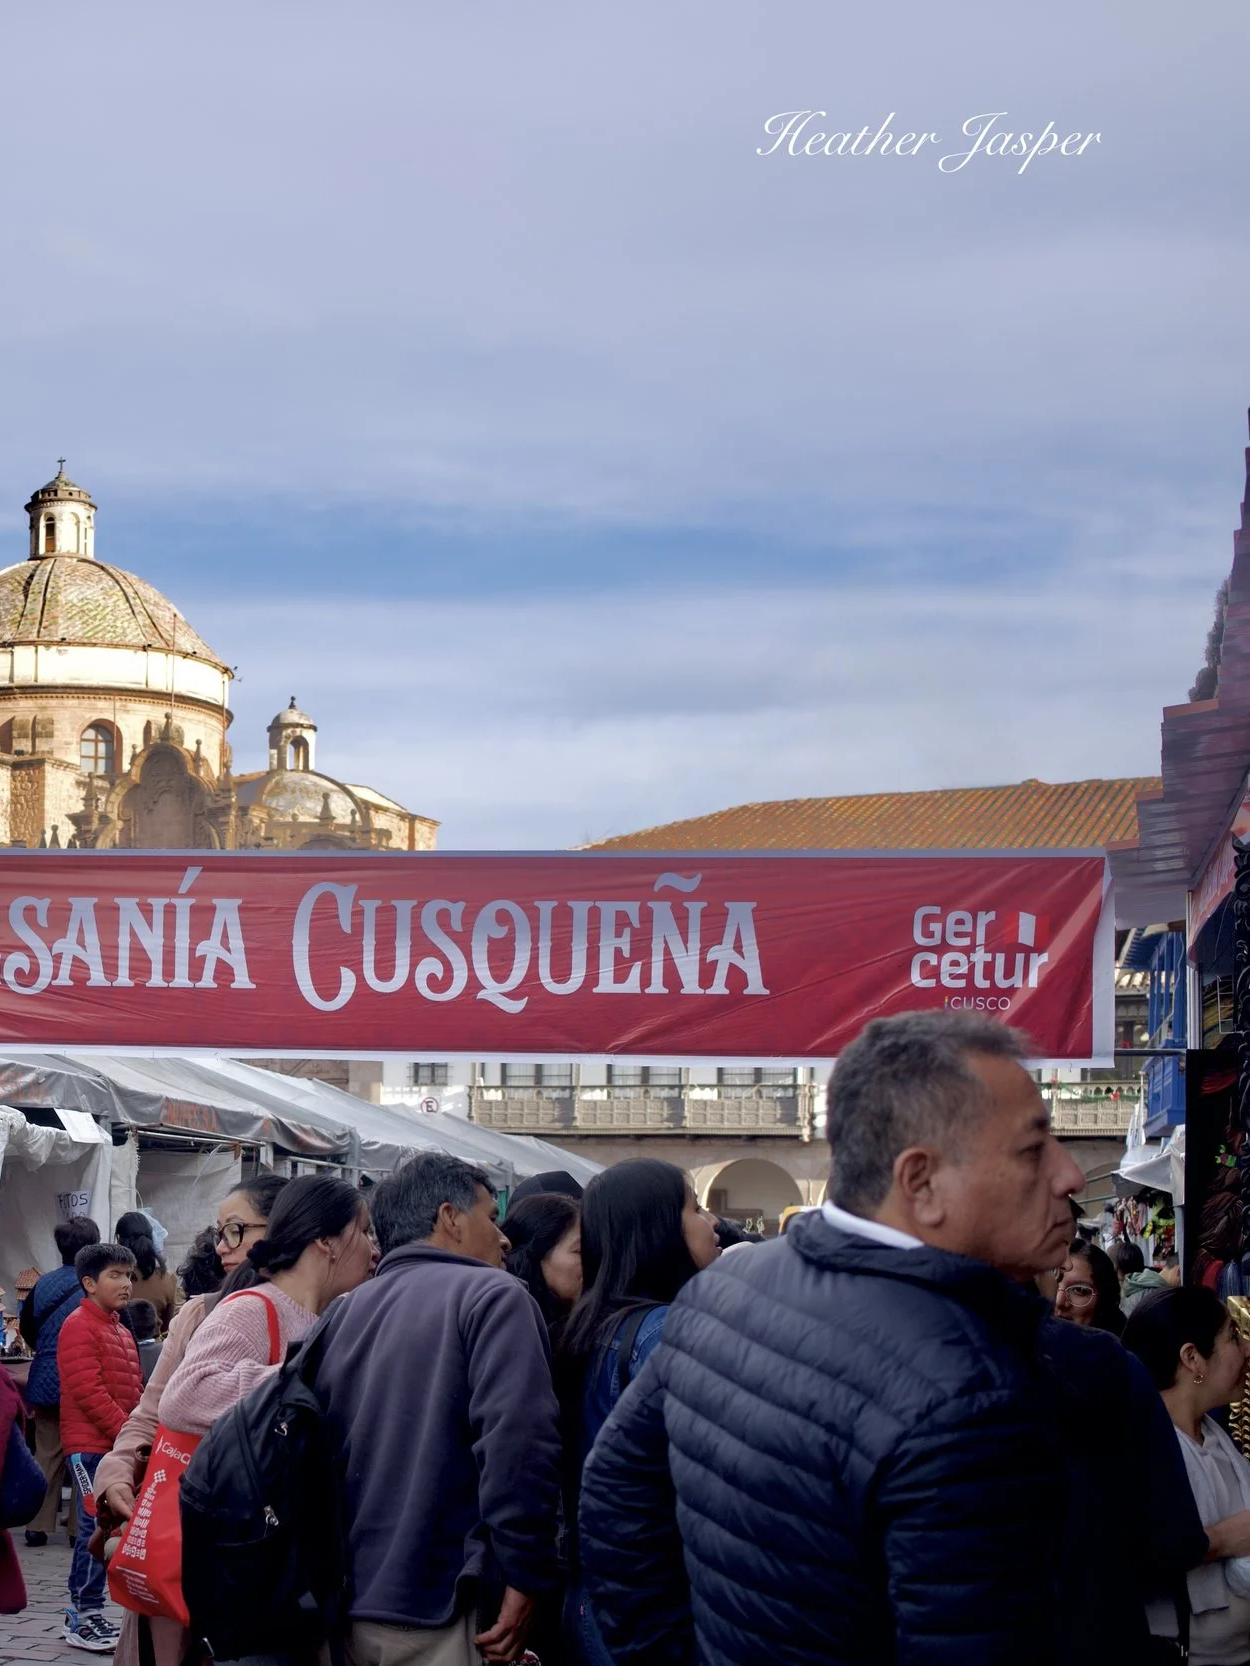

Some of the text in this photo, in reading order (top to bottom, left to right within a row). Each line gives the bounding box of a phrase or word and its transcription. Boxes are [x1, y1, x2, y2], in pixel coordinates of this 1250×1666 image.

[291, 871, 771, 1014] CUSQUEÑA
[913, 905, 996, 947] Ger
[910, 945, 1049, 989] cetur
[950, 996, 1011, 1011] CUSCO
[75, 1463, 92, 1495] SPIDER-MAN
